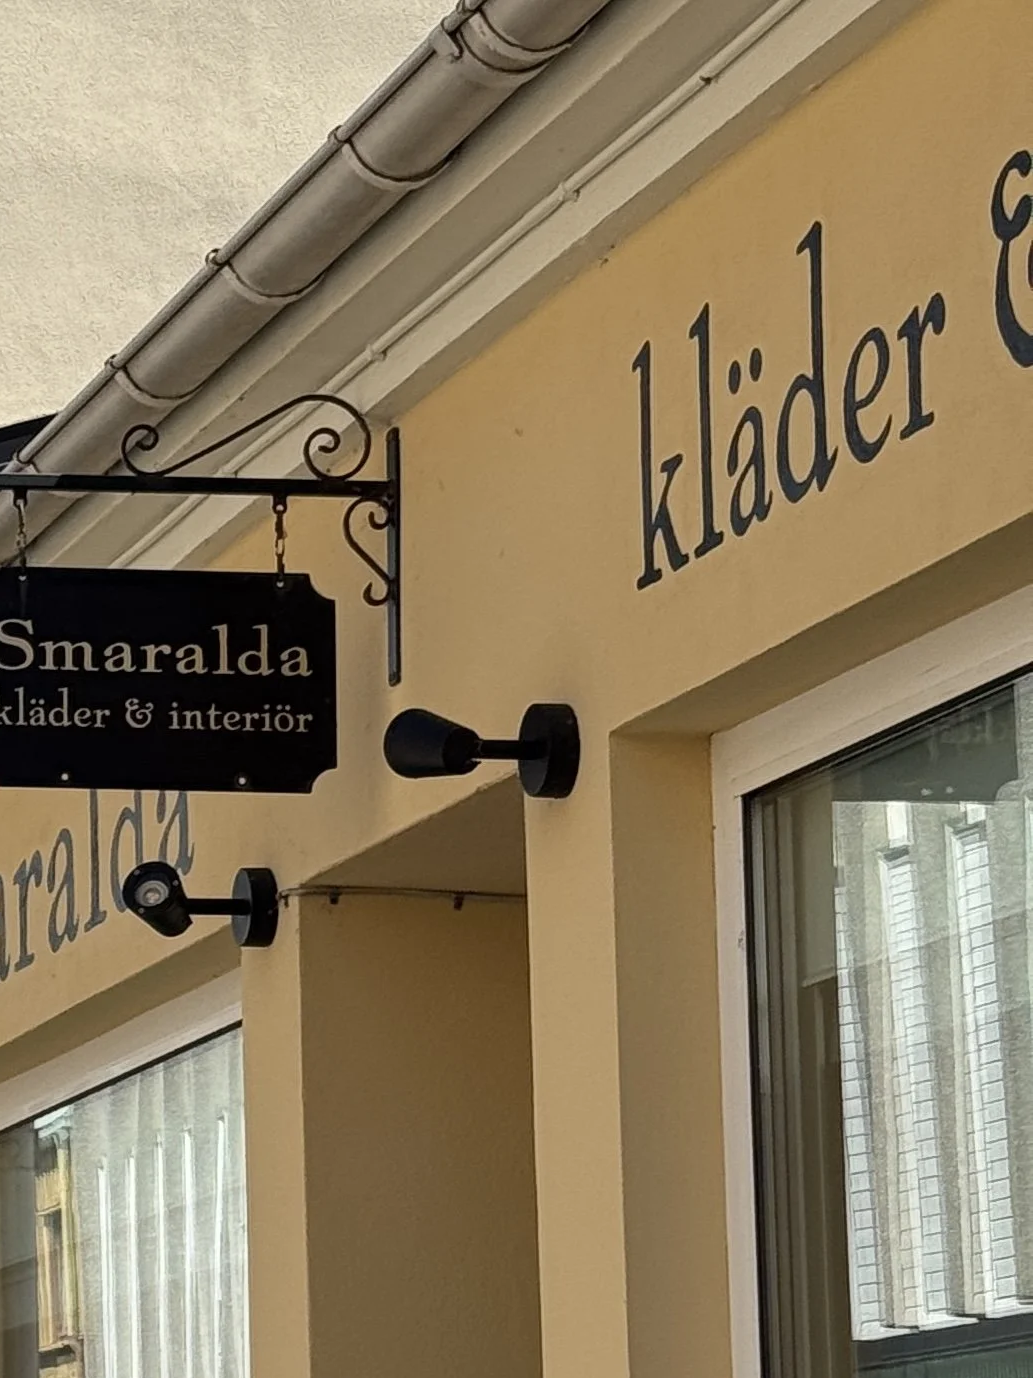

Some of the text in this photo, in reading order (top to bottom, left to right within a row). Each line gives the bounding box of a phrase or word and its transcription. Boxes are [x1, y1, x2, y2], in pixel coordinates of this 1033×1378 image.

[632, 220, 946, 591] kläder
[125, 697, 154, 729] &
[168, 700, 314, 733] interiör
